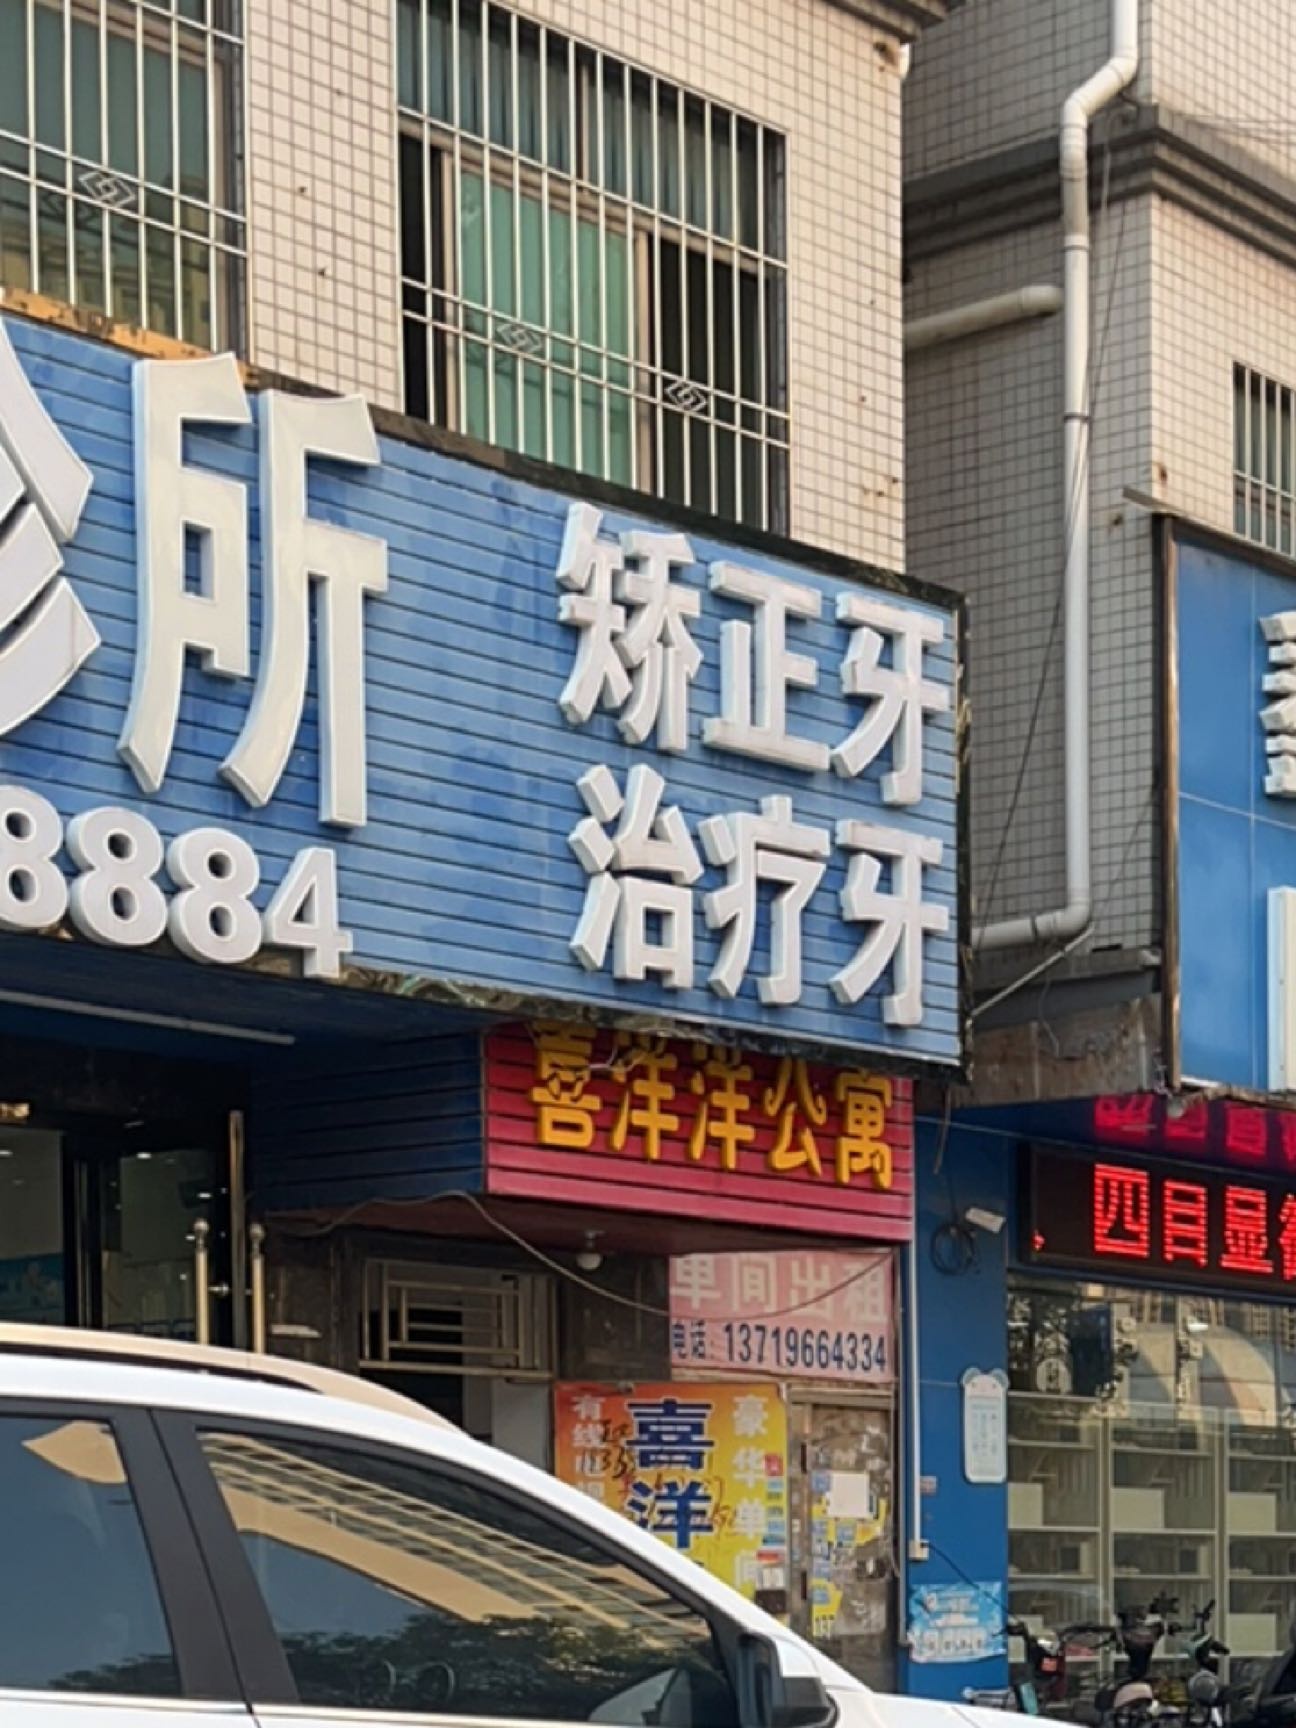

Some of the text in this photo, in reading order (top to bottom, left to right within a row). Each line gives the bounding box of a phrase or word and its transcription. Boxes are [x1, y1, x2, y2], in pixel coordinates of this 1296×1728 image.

[556, 502, 949, 805] 矫正牙
[568, 764, 949, 1026] 治疗牙
[529, 1020, 892, 1190] 喜洋洋公寓
[723, 1322, 887, 1373] 13719664334
